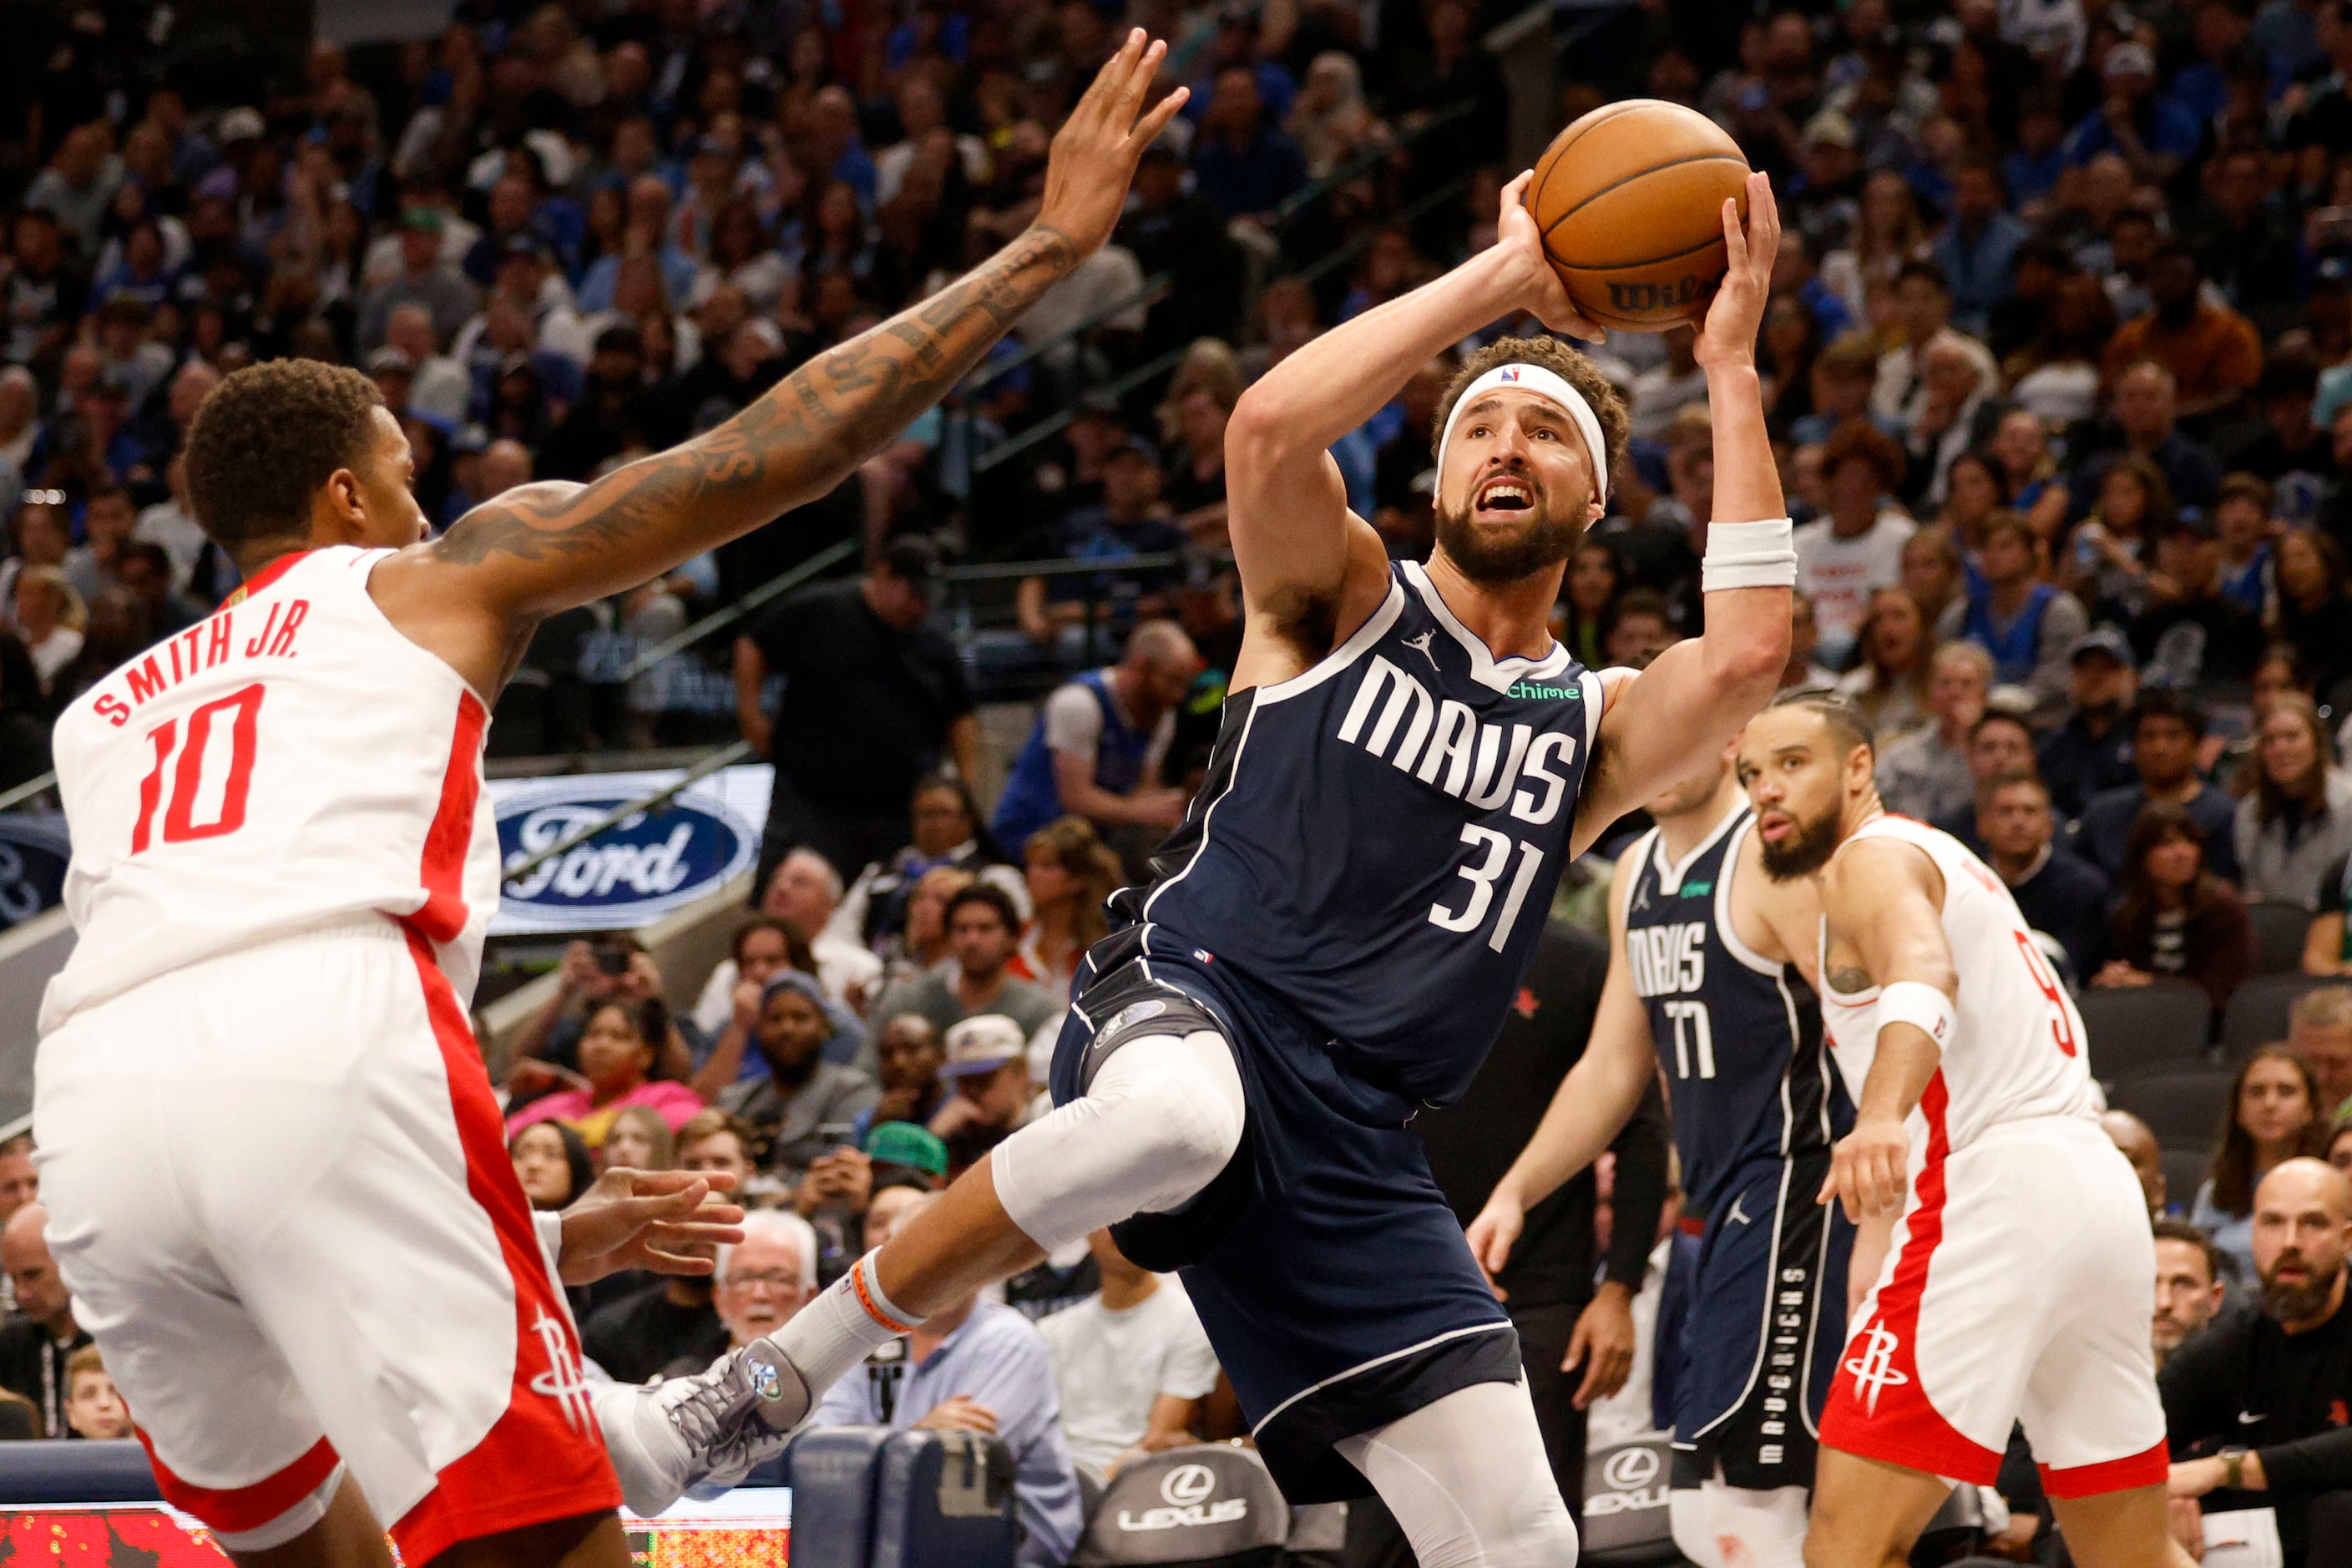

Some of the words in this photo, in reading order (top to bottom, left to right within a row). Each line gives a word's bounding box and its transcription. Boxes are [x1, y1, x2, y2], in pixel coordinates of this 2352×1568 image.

[1606, 274, 1714, 311] Wil
[93, 611, 233, 727] SMITH
[245, 599, 310, 658] JR.
[1506, 681, 1580, 700] chime
[130, 683, 266, 857] 10
[504, 806, 693, 899] Ford
[1428, 822, 1545, 953] 31
[1663, 1000, 1716, 1079] 77
[2013, 928, 2077, 1058] 9
[1758, 1267, 1806, 1464] MAVERICKS
[1117, 1497, 1247, 1531] LEXUS
[1582, 1485, 1670, 1517] EXU
